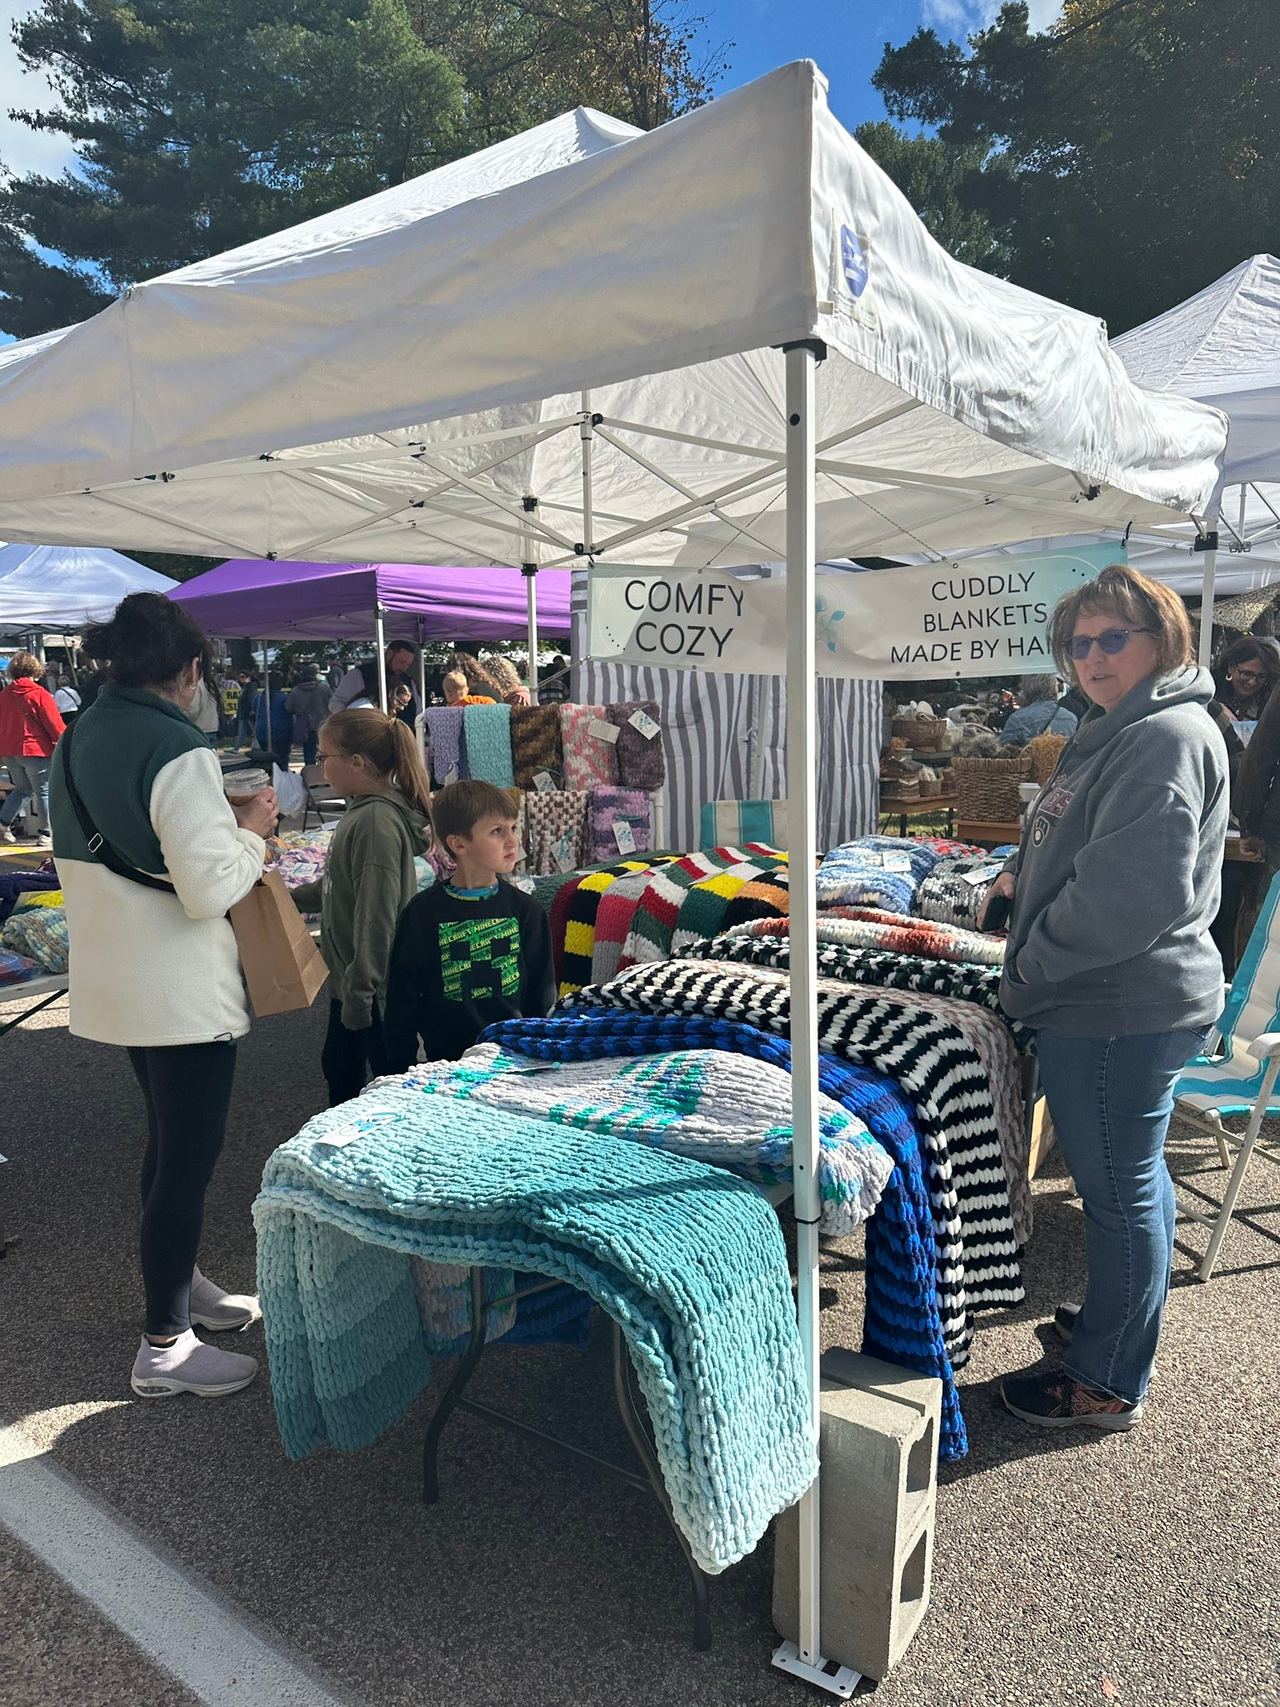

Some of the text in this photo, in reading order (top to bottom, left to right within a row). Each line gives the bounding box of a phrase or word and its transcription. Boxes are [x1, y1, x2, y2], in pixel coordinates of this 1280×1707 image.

[624, 579, 744, 617] COMFY
[931, 571, 1035, 601] CUDDLY
[924, 602, 1048, 633] BLANKETS
[635, 621, 734, 658] COZY
[891, 635, 1051, 664] MADE BY HA
